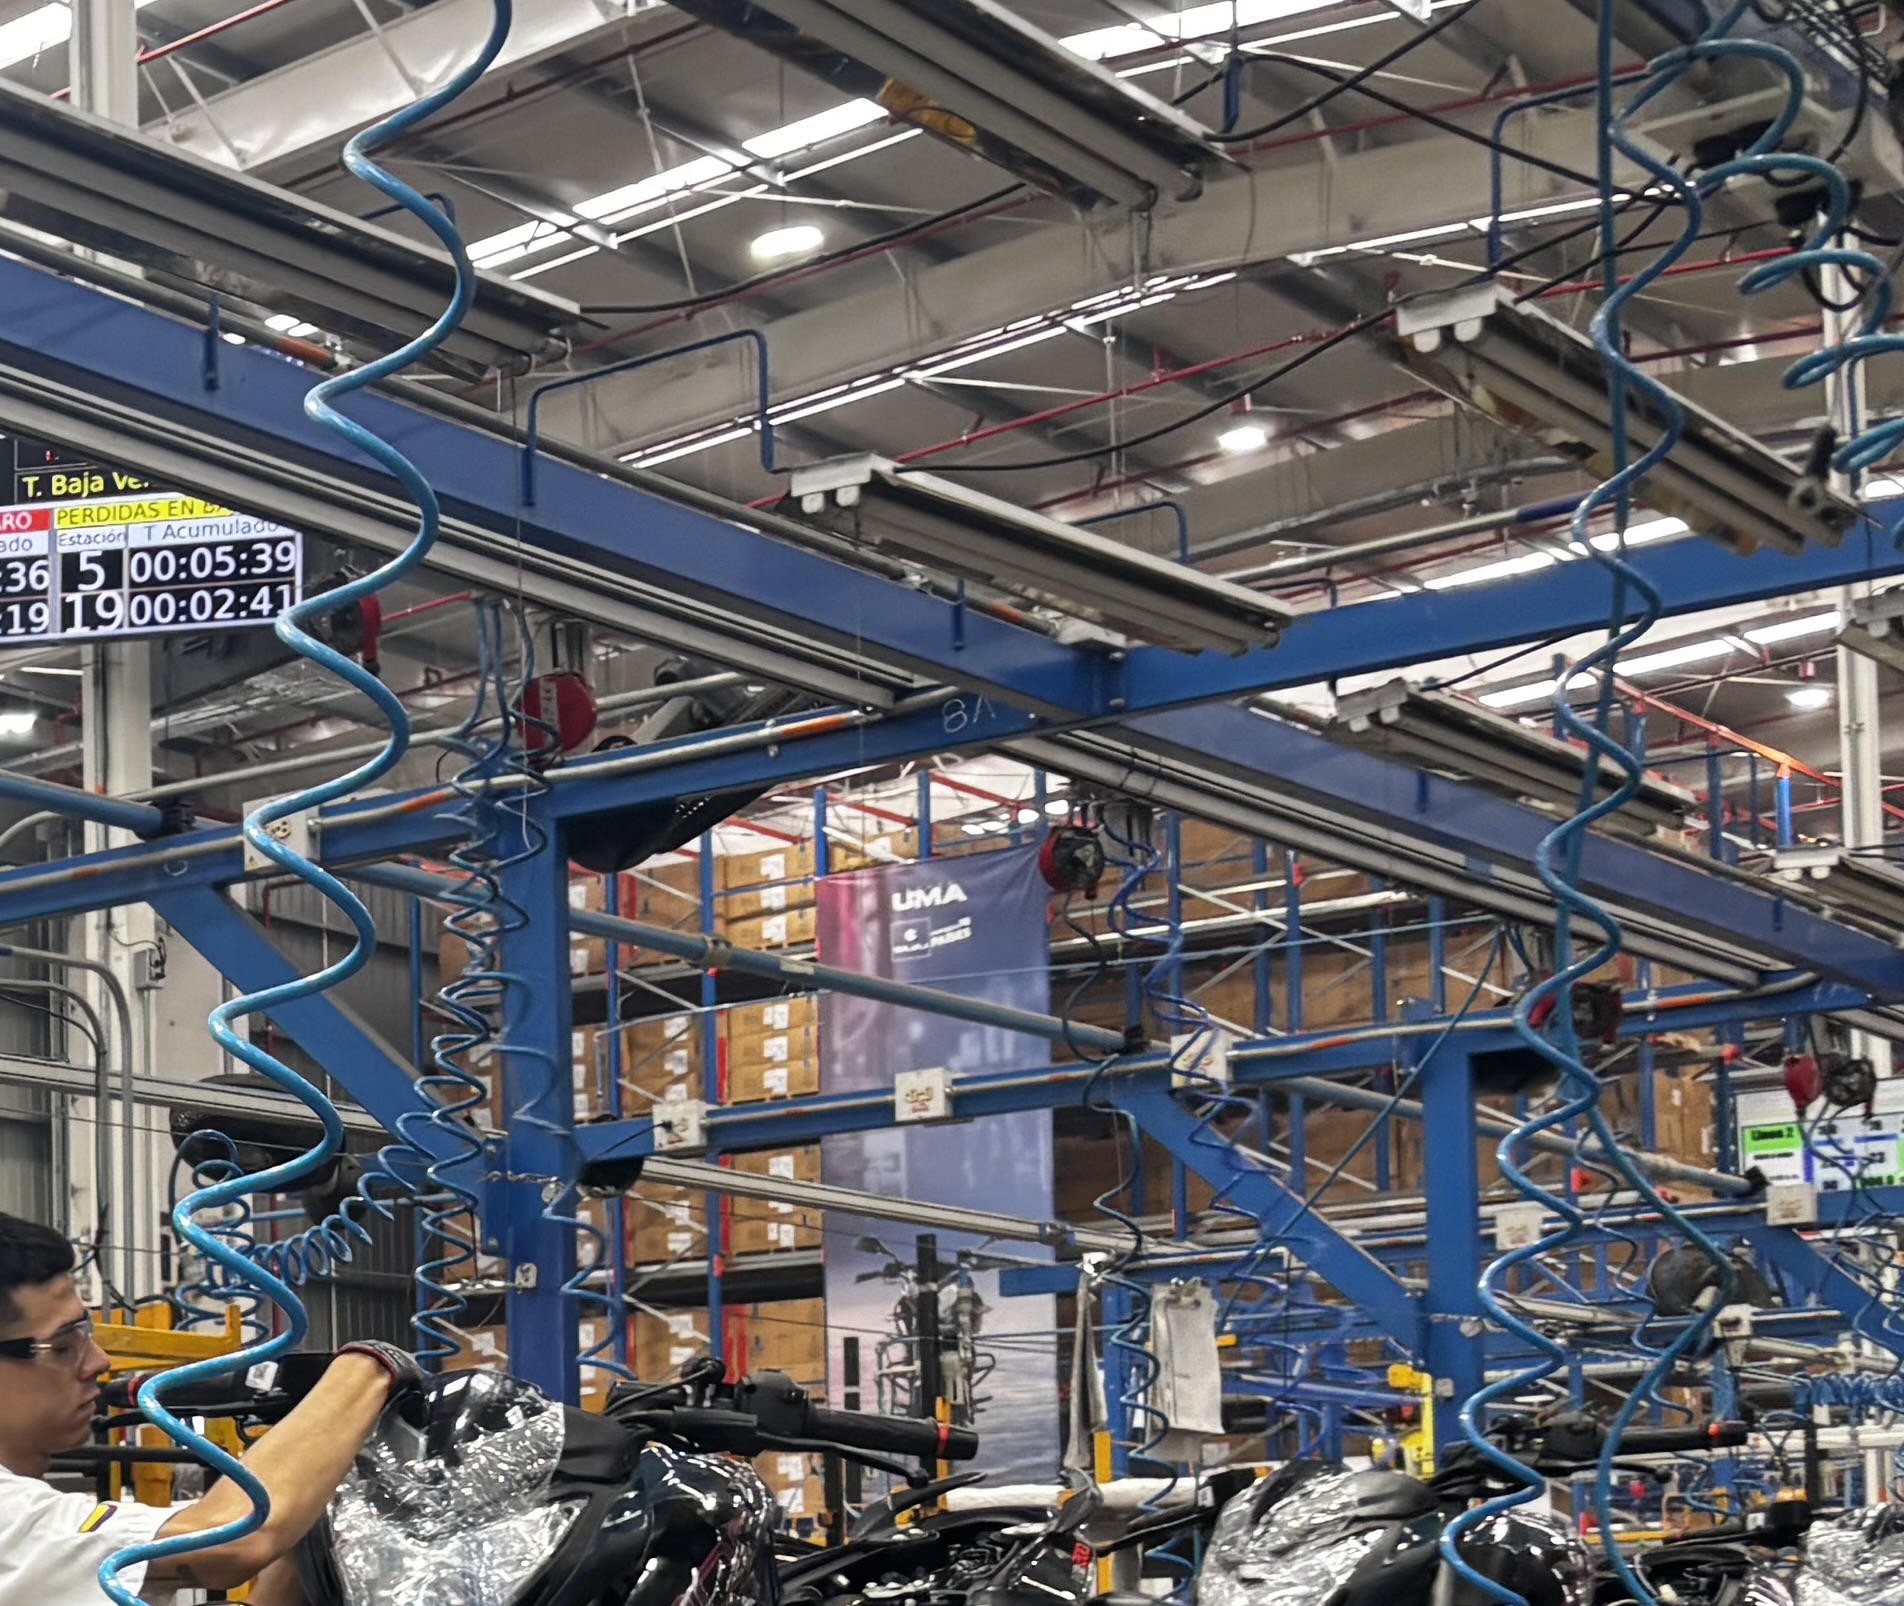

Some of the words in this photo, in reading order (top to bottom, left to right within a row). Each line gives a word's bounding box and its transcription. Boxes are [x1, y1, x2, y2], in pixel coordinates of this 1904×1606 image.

[21, 475, 42, 498] T.
[52, 471, 104, 498] Baja
[57, 501, 160, 525] PERDIDAS
[168, 499, 195, 516] EN
[57, 530, 126, 547] Estación
[144, 526, 157, 541] T
[77, 550, 106, 590] 5
[130, 541, 297, 583] 00:05:39
[65, 591, 124, 633] 19
[130, 585, 293, 626] 00:02:41
[892, 883, 968, 912] UMA
